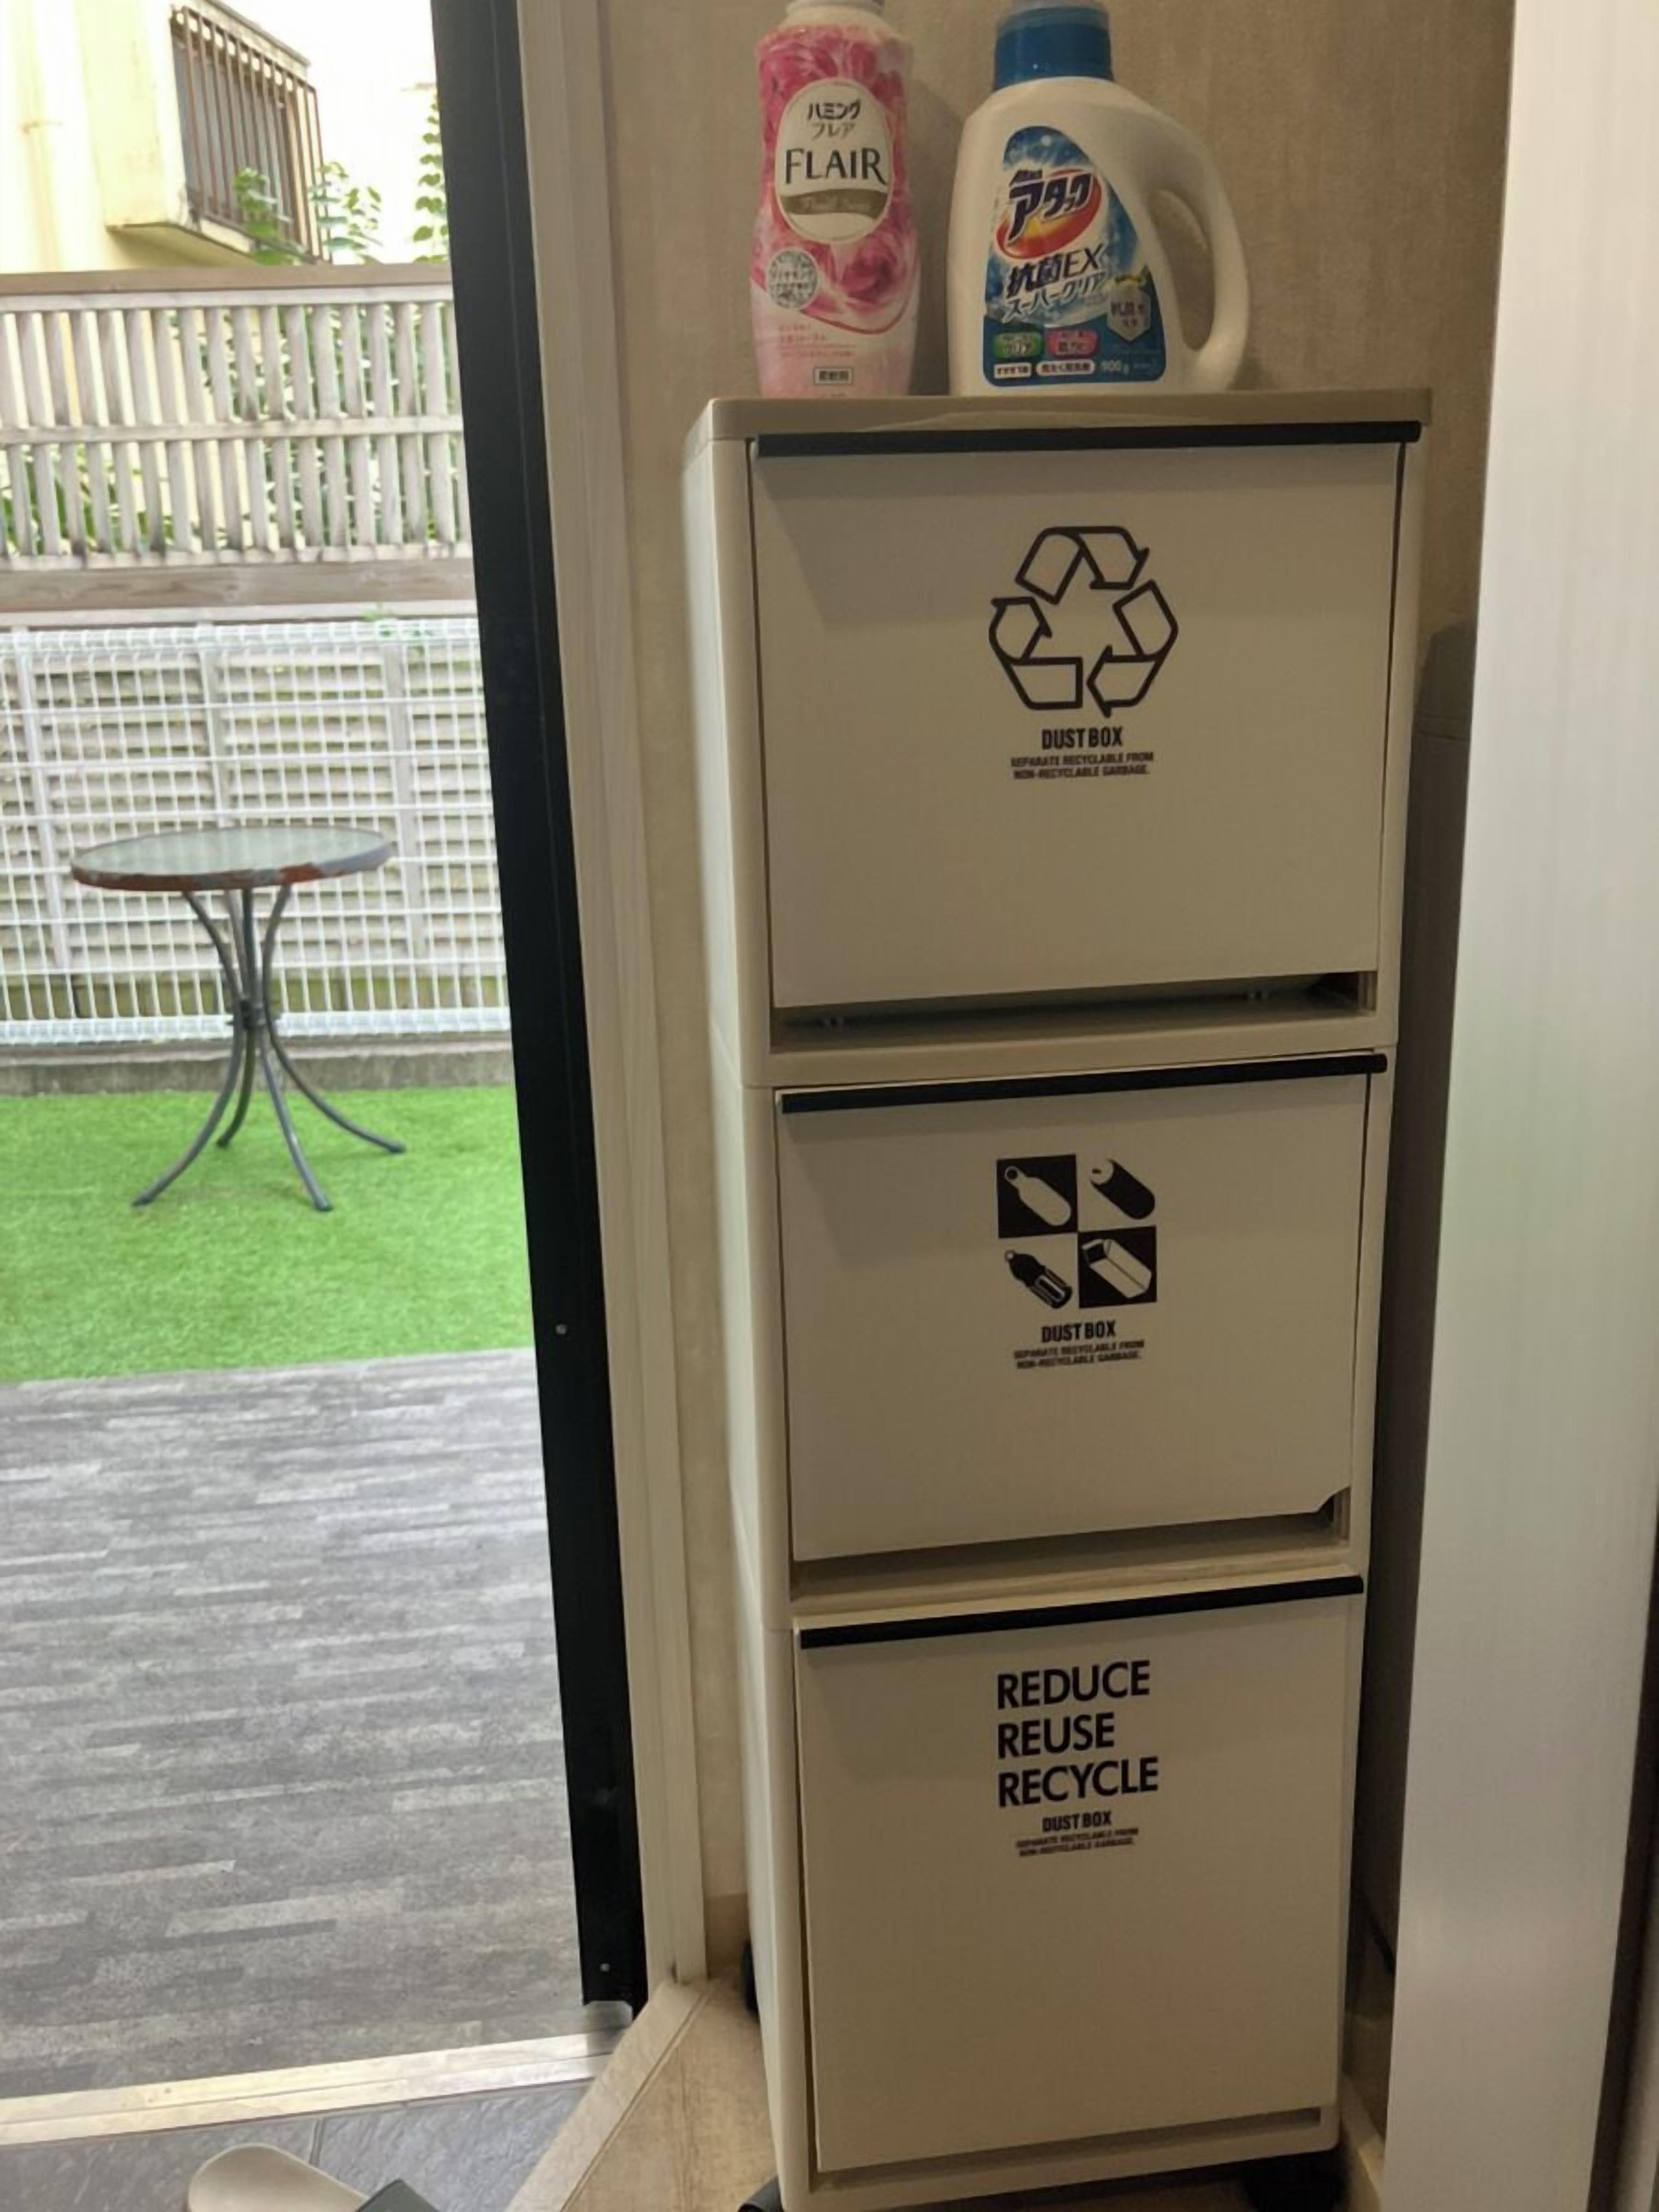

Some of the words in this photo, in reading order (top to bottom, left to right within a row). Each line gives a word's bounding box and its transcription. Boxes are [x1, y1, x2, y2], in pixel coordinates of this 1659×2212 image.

[807, 99, 861, 121] ハミング
[812, 122, 854, 141] フレア
[786, 147, 887, 185] FLAIR
[1009, 170, 1092, 241] アタック
[1006, 243, 1104, 299] 抗菌EX
[1042, 728, 1085, 749] DUST
[1088, 726, 1123, 747] BOX
[1041, 1323, 1082, 1343] DUST
[1085, 1320, 1116, 1339] BOX
[998, 1660, 1150, 1710] REDUCE
[998, 1712, 1114, 1759] REUSE
[999, 1757, 1159, 1808] RECYCLE
[1042, 1814, 1080, 1832] DUST
[1082, 1811, 1112, 1828] BOX
